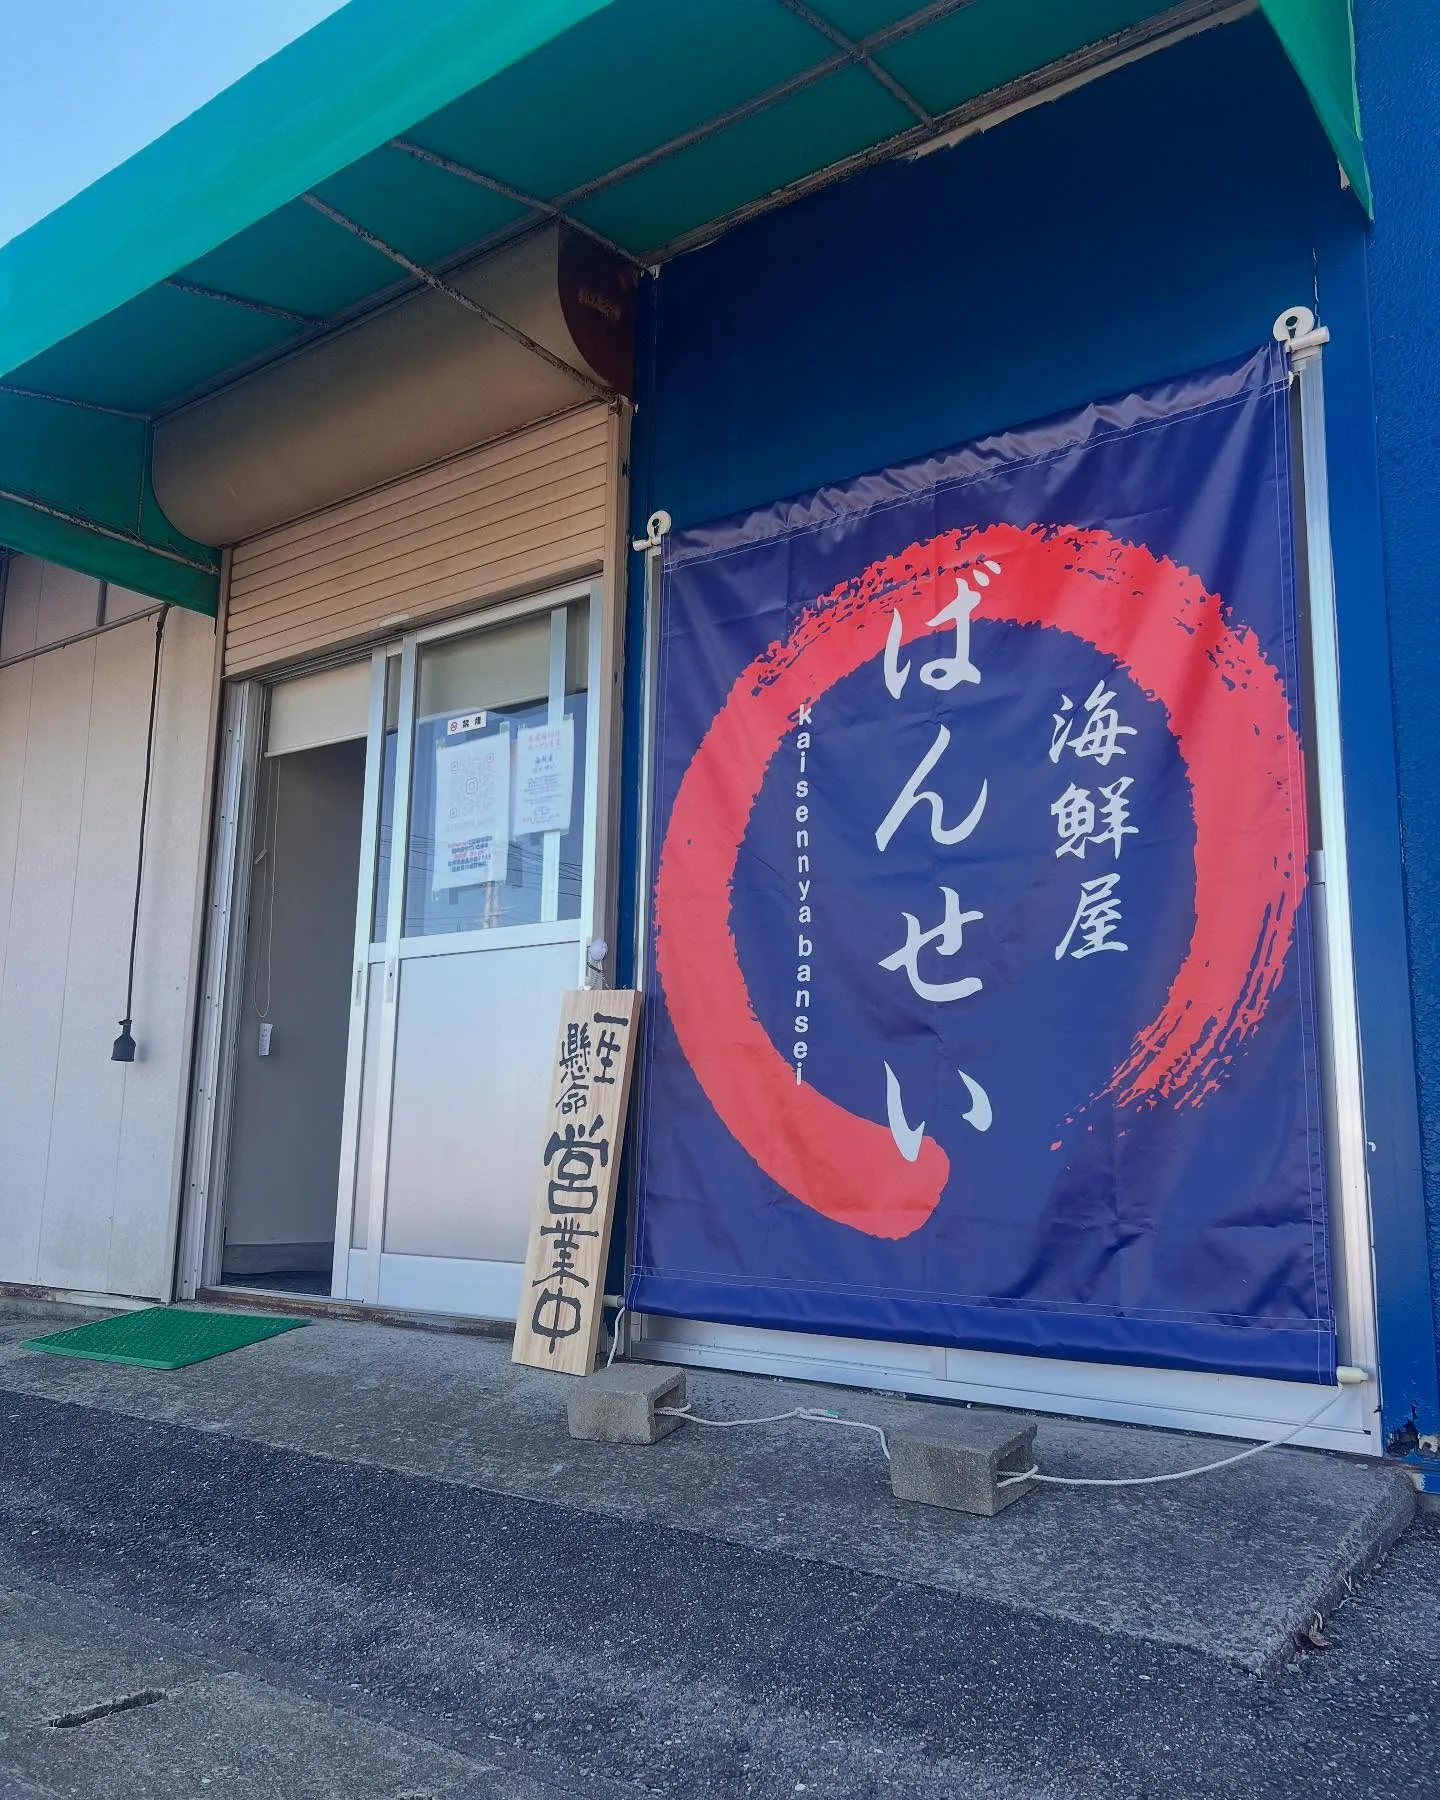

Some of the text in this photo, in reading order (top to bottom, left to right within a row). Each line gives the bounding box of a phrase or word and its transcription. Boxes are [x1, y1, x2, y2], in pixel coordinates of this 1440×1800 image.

[793, 703, 813, 1085] kaisennya bansei
[875, 560, 1002, 1162] ばんせい
[1049, 680, 1140, 961] 海鮮屋
[531, 1114, 610, 1354] 営業中
